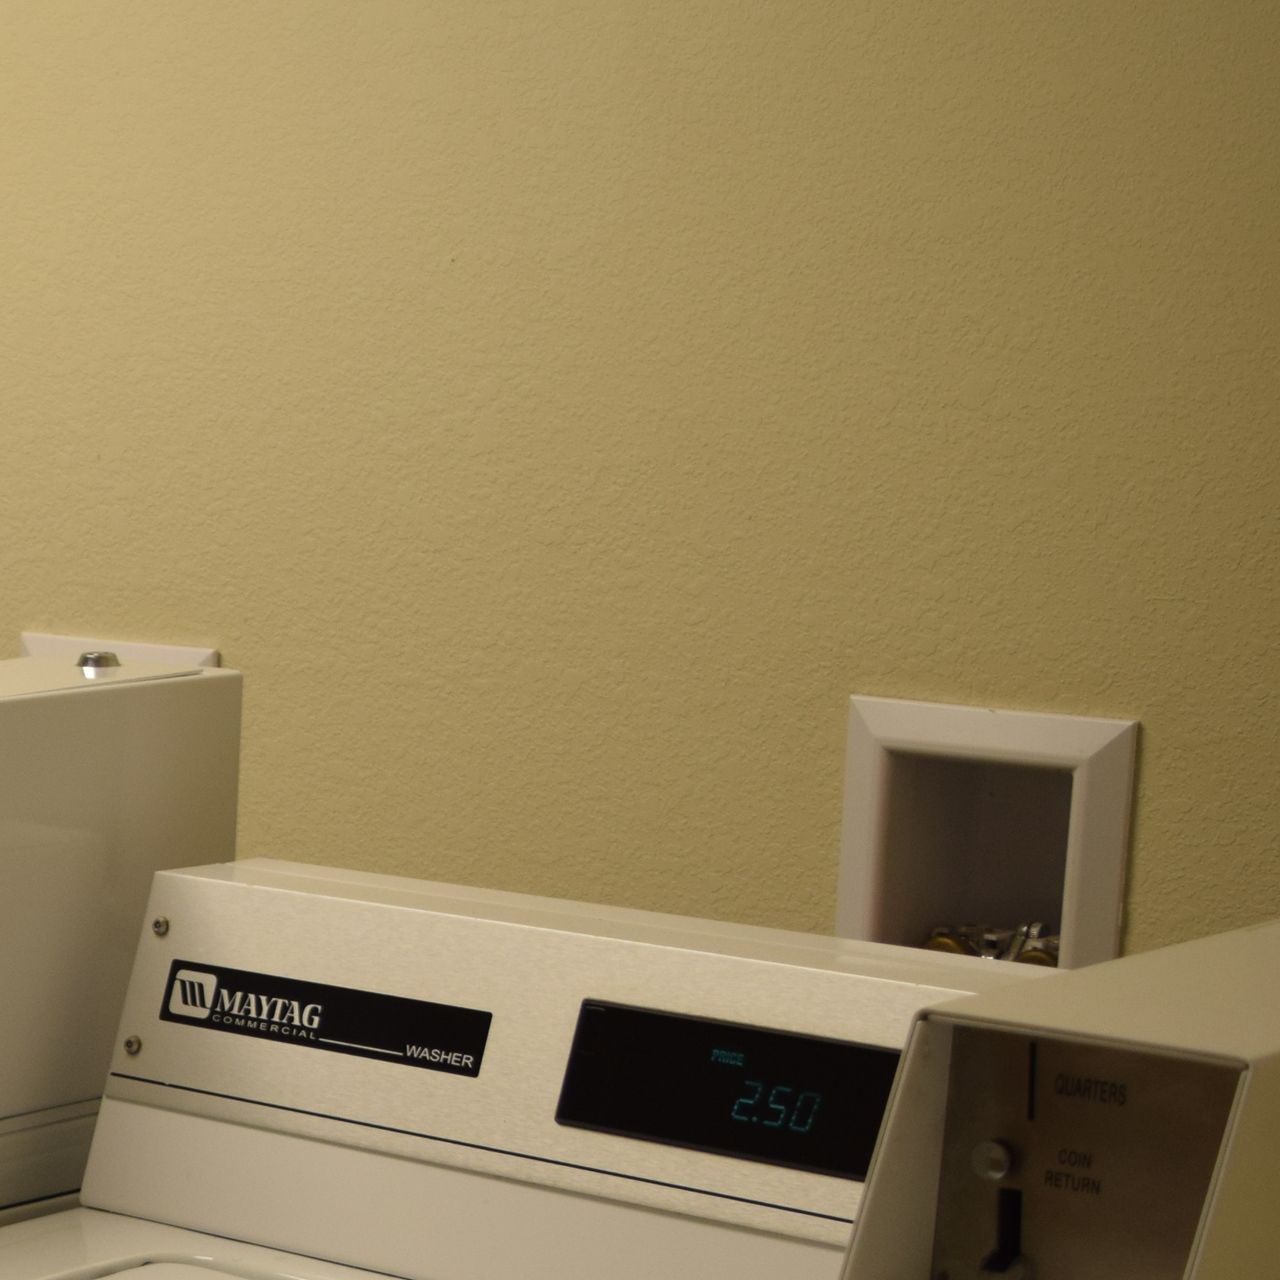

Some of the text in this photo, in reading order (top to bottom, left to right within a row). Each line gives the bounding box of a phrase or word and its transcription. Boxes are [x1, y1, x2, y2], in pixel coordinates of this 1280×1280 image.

[214, 988, 322, 1029] MAYTAG
[212, 1014, 318, 1040] COMMERCIAL
[405, 1043, 474, 1069] WASHER
[710, 1048, 745, 1067] PRICE
[1055, 1072, 1128, 1106] QUARTERS
[730, 1079, 823, 1133] 2.50
[1057, 1148, 1093, 1168] COIN
[1043, 1169, 1102, 1195] RETURN
